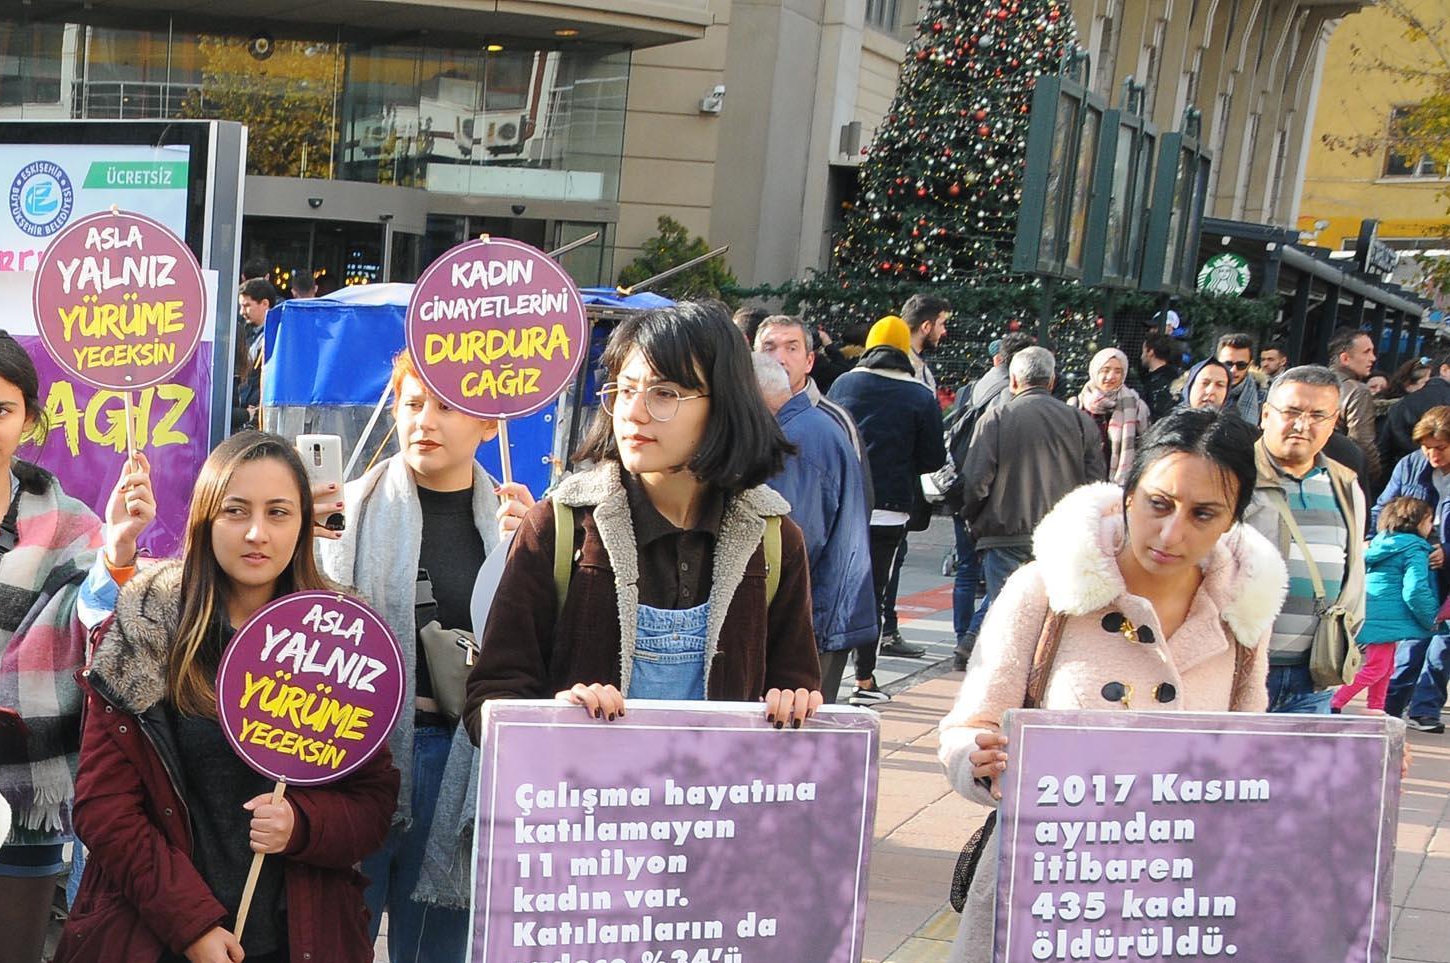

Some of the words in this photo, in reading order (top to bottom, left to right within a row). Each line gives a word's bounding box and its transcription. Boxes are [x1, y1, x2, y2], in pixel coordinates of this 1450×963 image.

[21, 161, 62, 180] ESKİŞEHİR
[106, 167, 172, 185] ÜCRETSİZ
[12, 187, 42, 236] BÜYÜKŞEHİR
[44, 187, 72, 235] BELEDİYESİ
[85, 225, 143, 252] ASLA
[57, 255, 178, 295] YALNIZ
[451, 259, 534, 290] KADIN
[58, 292, 185, 343] YÜRÜME
[419, 287, 569, 322] CİNAYETLERİNİ
[73, 337, 176, 371] YECEKSİN
[424, 323, 571, 365] DURDURA
[460, 363, 542, 399] CAĞIZ
[302, 604, 366, 647] ASLA
[260, 623, 388, 693] YALNIZ
[239, 669, 374, 741] YÜRÜME
[239, 717, 347, 770] YECEKSİN
[515, 782, 650, 815] Çalışma
[665, 779, 817, 810] hayatına
[1037, 775, 1137, 805] 2017
[1152, 773, 1270, 802] Kasım
[515, 816, 736, 846] katılamayan
[1035, 811, 1195, 850] ayından
[518, 854, 553, 879] 11
[571, 850, 688, 881] milyon
[1033, 852, 1194, 882] itibaren
[513, 886, 612, 913] kadın
[624, 888, 689, 909] var.
[1031, 891, 1106, 920] 435
[1121, 888, 1237, 919] kadın
[513, 915, 724, 947] Katılanların
[737, 912, 778, 938] da
[1031, 925, 1238, 960] öldürüldü.
